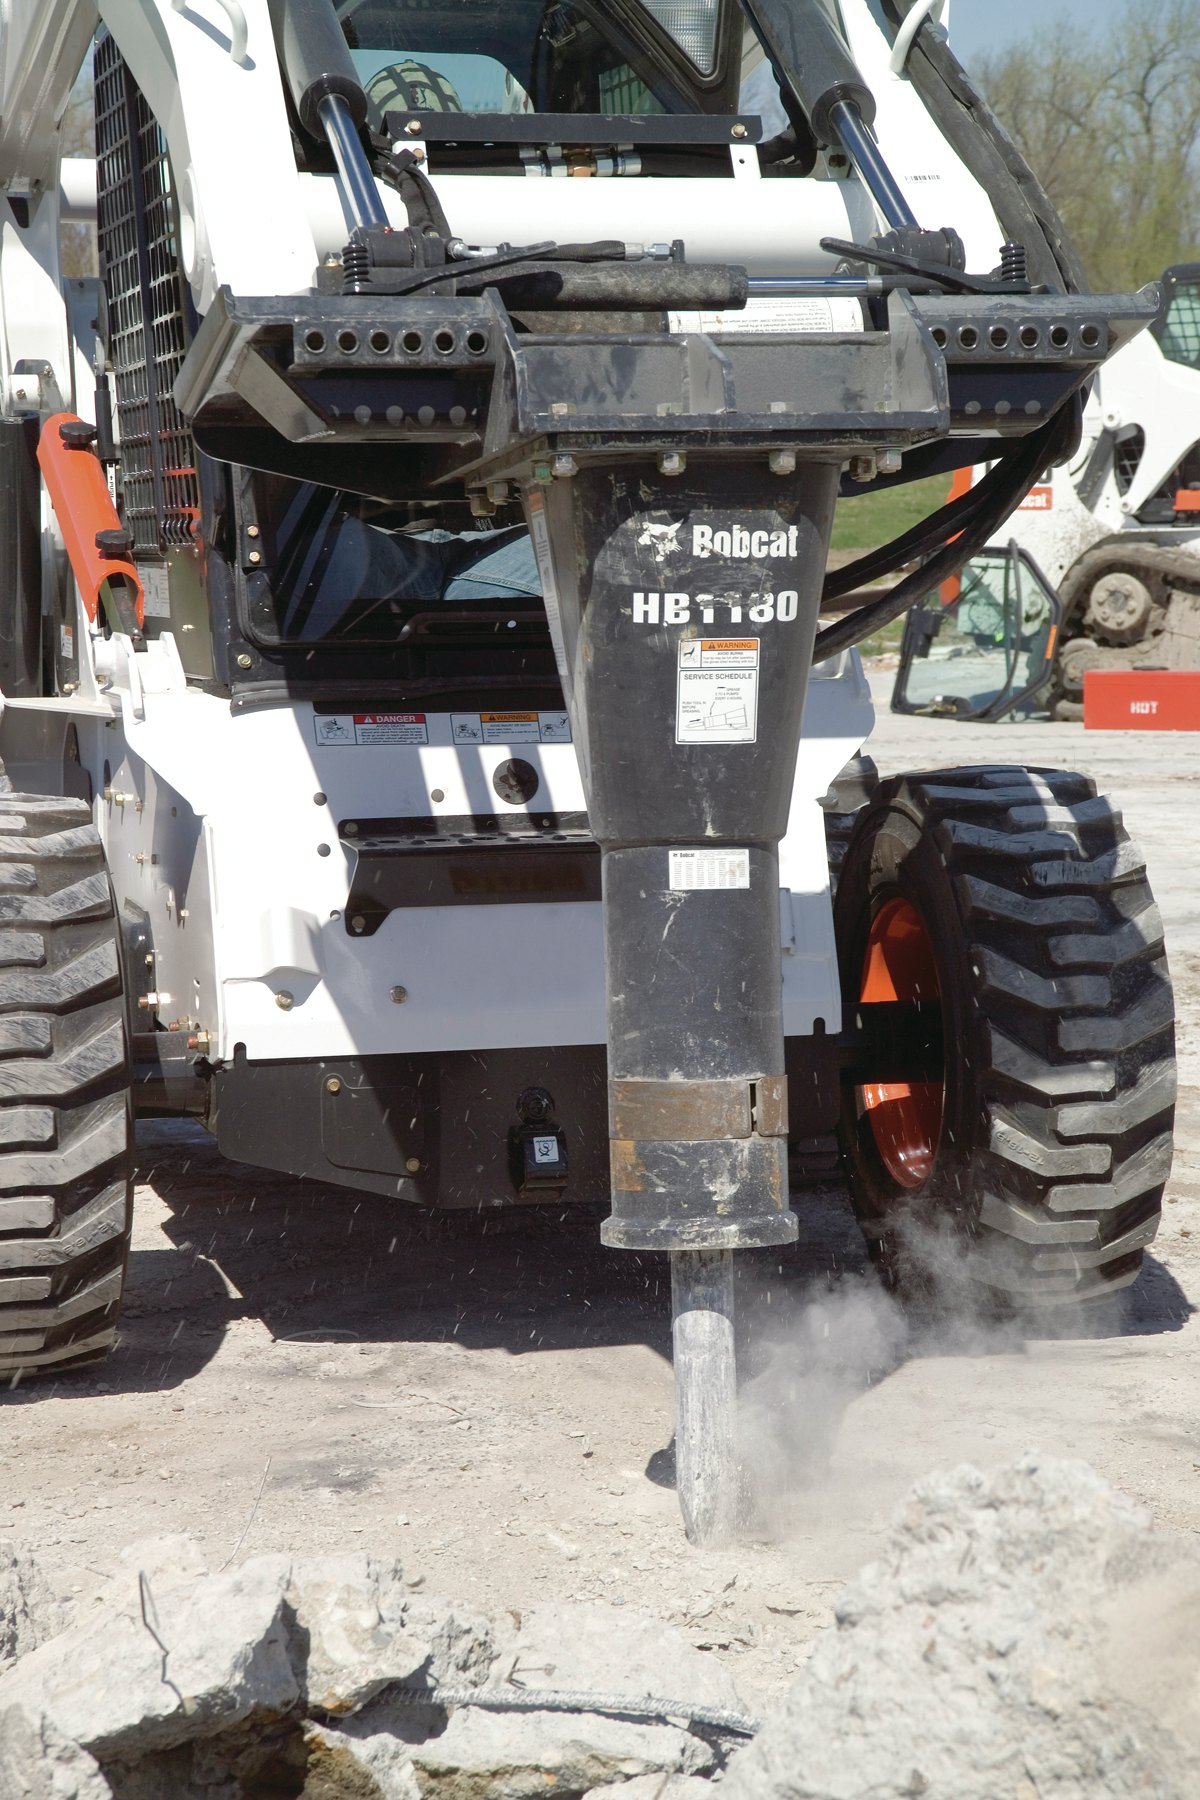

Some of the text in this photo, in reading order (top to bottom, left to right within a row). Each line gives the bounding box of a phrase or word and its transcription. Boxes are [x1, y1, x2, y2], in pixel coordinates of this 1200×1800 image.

[693, 525, 798, 558] Bobcat
[632, 590, 798, 624] HB1180
[715, 672, 753, 680] SCHEDULE
[376, 715, 416, 723] DANGER
